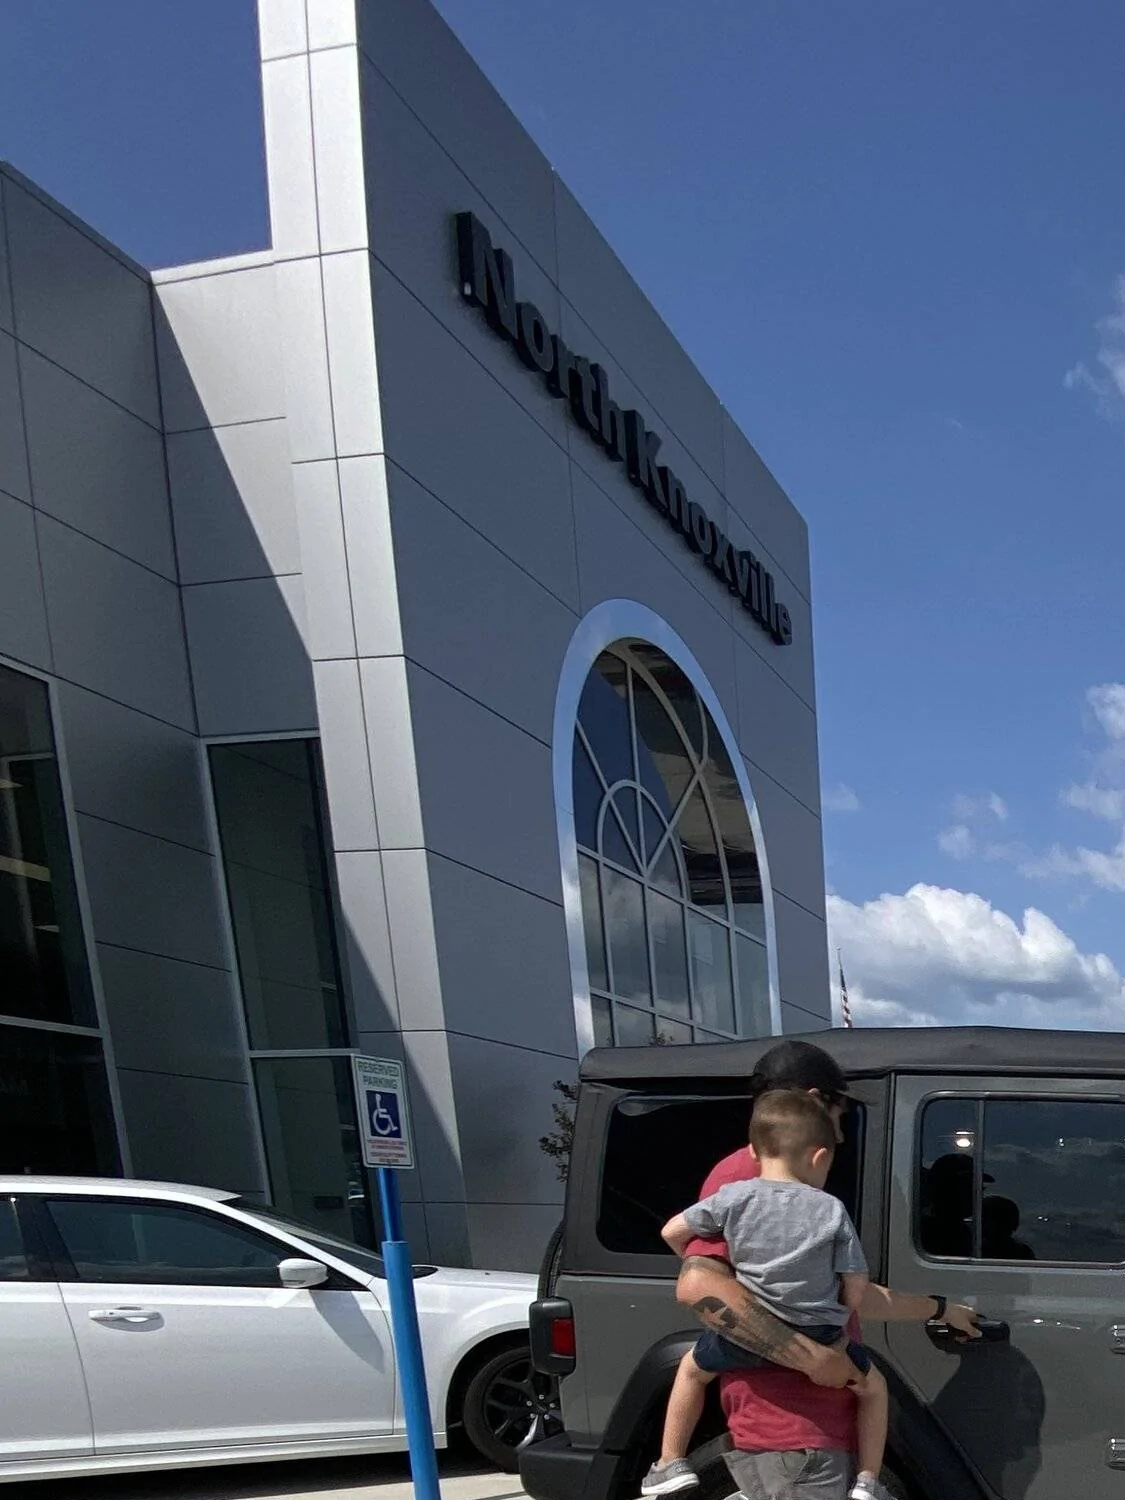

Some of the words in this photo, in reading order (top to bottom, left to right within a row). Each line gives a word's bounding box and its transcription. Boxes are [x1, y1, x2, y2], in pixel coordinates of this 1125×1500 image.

[455, 211, 625, 463] North
[623, 409, 793, 647] Knoxville
[357, 1061, 400, 1077] RESERVED
[363, 1075, 398, 1090] PARKING
